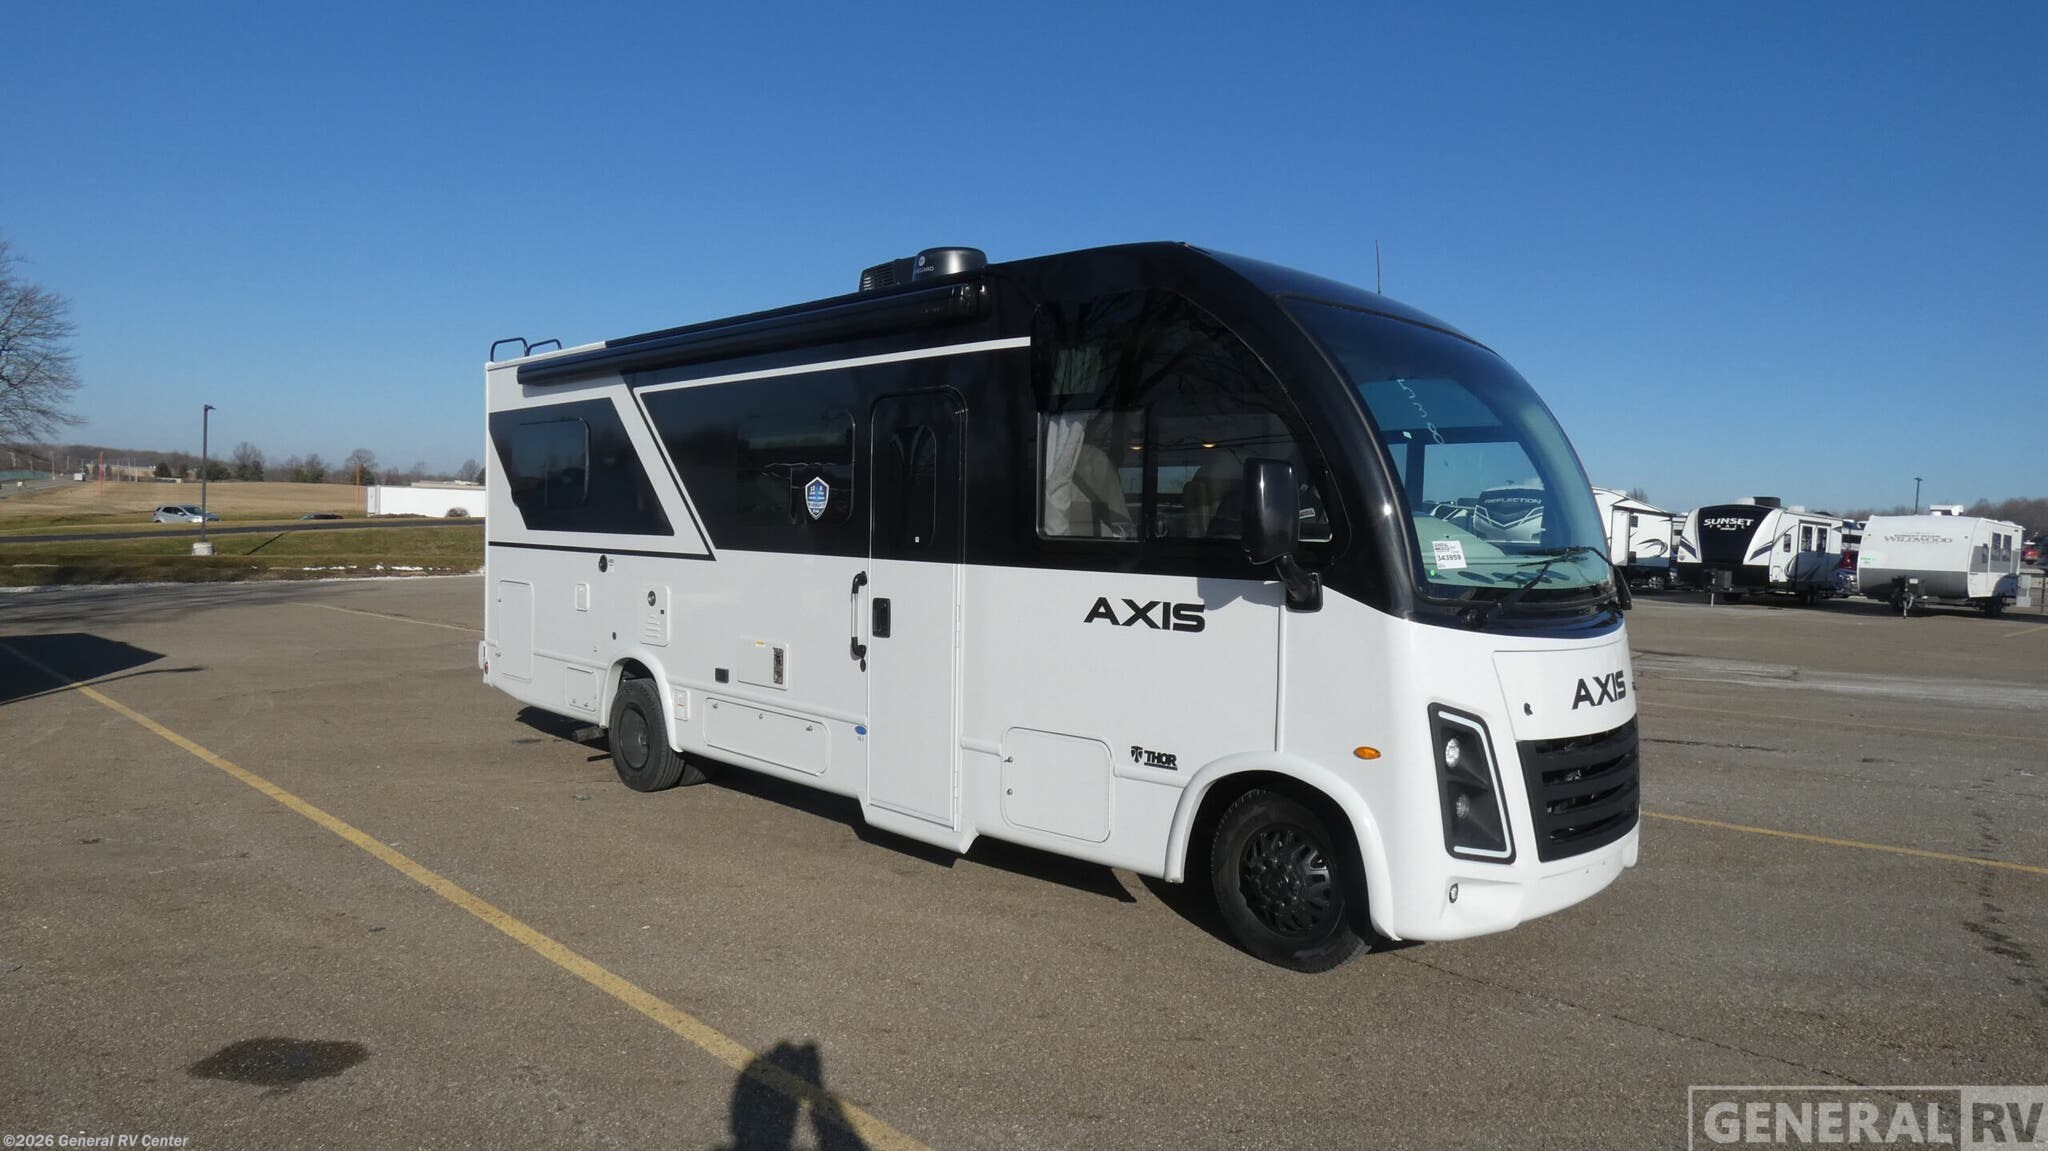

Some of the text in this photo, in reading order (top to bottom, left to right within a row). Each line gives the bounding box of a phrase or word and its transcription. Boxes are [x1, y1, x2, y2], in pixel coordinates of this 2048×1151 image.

[1703, 517, 1754, 526] SUNSET
[1083, 596, 1206, 633] AXIS
[1572, 669, 1627, 711] AXIS
[1143, 749, 1178, 767] THOR
